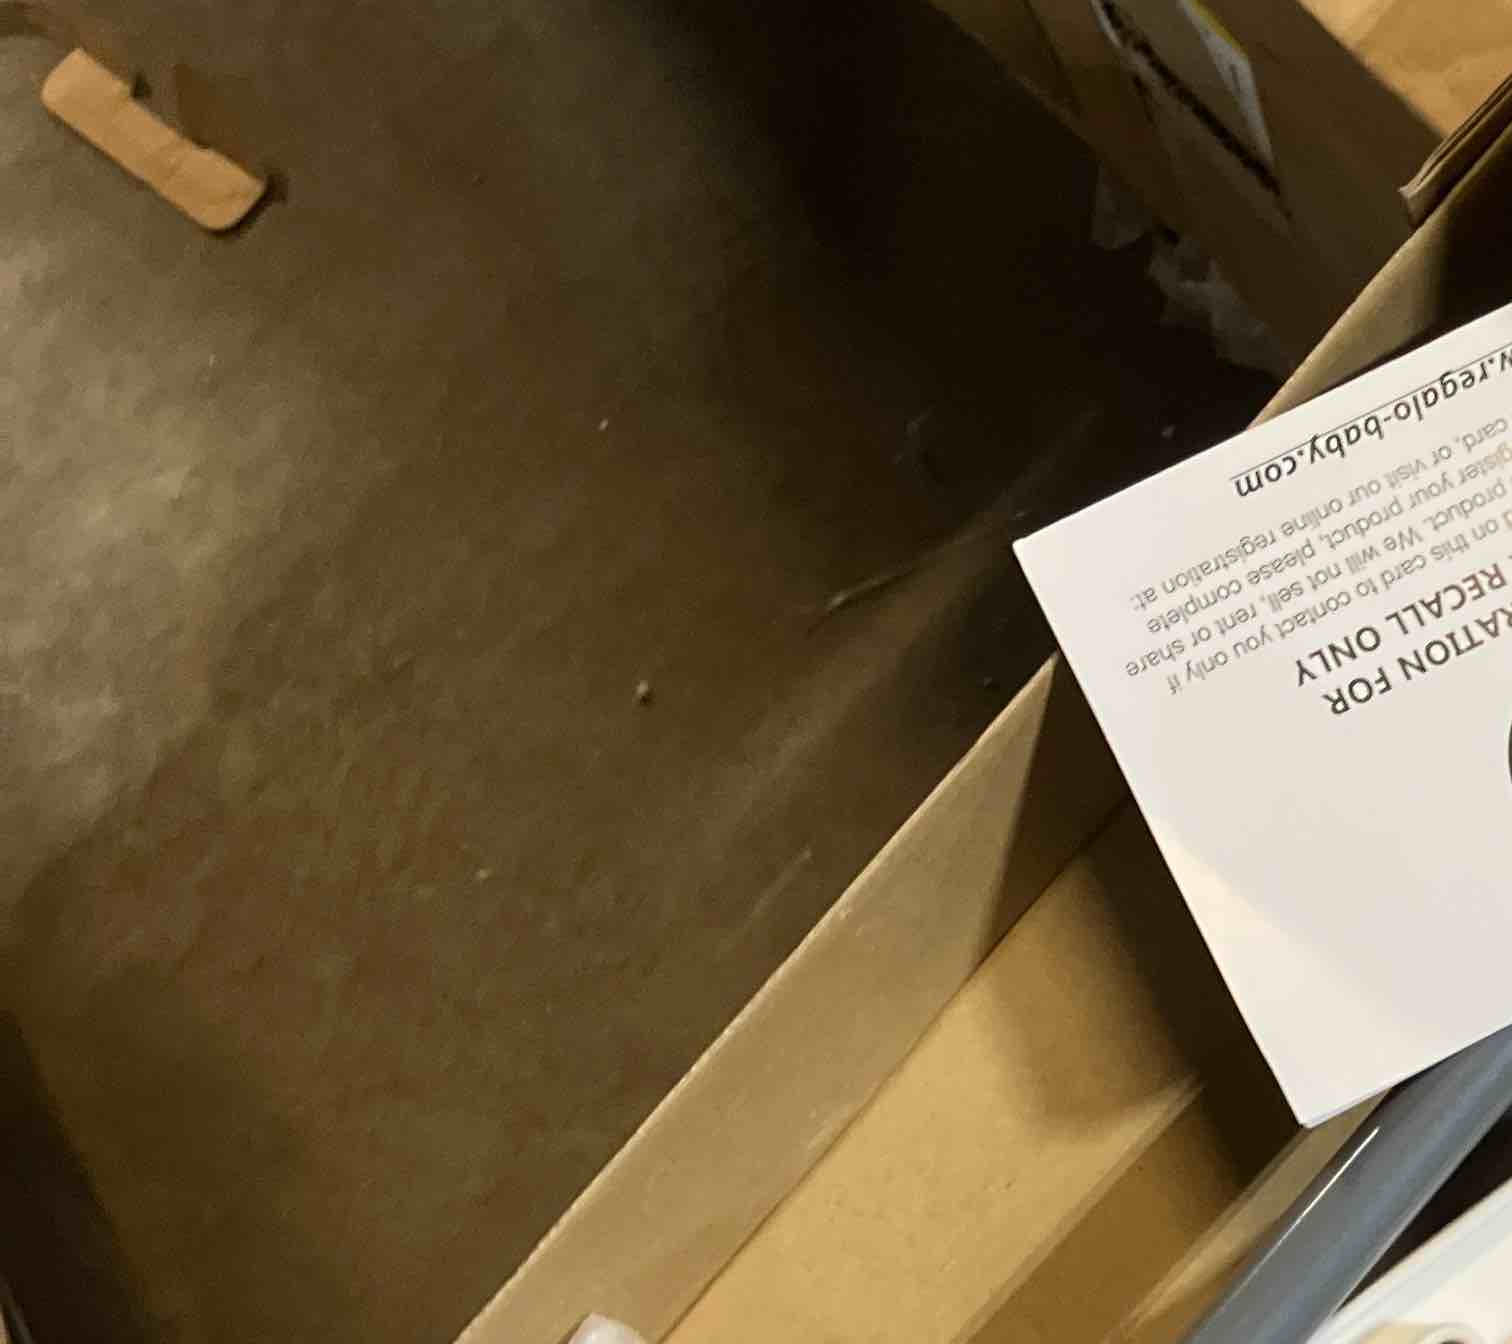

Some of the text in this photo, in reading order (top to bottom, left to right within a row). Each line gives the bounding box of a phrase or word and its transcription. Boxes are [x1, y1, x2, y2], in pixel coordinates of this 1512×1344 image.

[1431, 444, 1453, 465] or
[1383, 458, 1428, 490] visit
[1409, 471, 1453, 508] your
[1348, 479, 1382, 506] our
[1279, 497, 1344, 537] online
[1471, 518, 1500, 541] on
[1382, 526, 1423, 552] We
[1429, 533, 1470, 562] this
[1161, 529, 1277, 595] registration
[1246, 538, 1317, 586] please
[1344, 545, 1380, 575] will
[1379, 554, 1427, 590] card
[1306, 562, 1343, 592] not
[1355, 577, 1379, 598] to
[1146, 579, 1243, 634] complete
[1274, 591, 1353, 640] contact
[1384, 562, 1507, 636] RECALL
[1214, 603, 1258, 636] rent
[1191, 626, 1212, 648] or
[1232, 624, 1272, 659] you
[1125, 639, 1186, 677] share
[1185, 650, 1229, 682] only
[1295, 626, 1382, 687] ONLY
[1166, 673, 1183, 695] if
[1322, 666, 1392, 715] FOR
